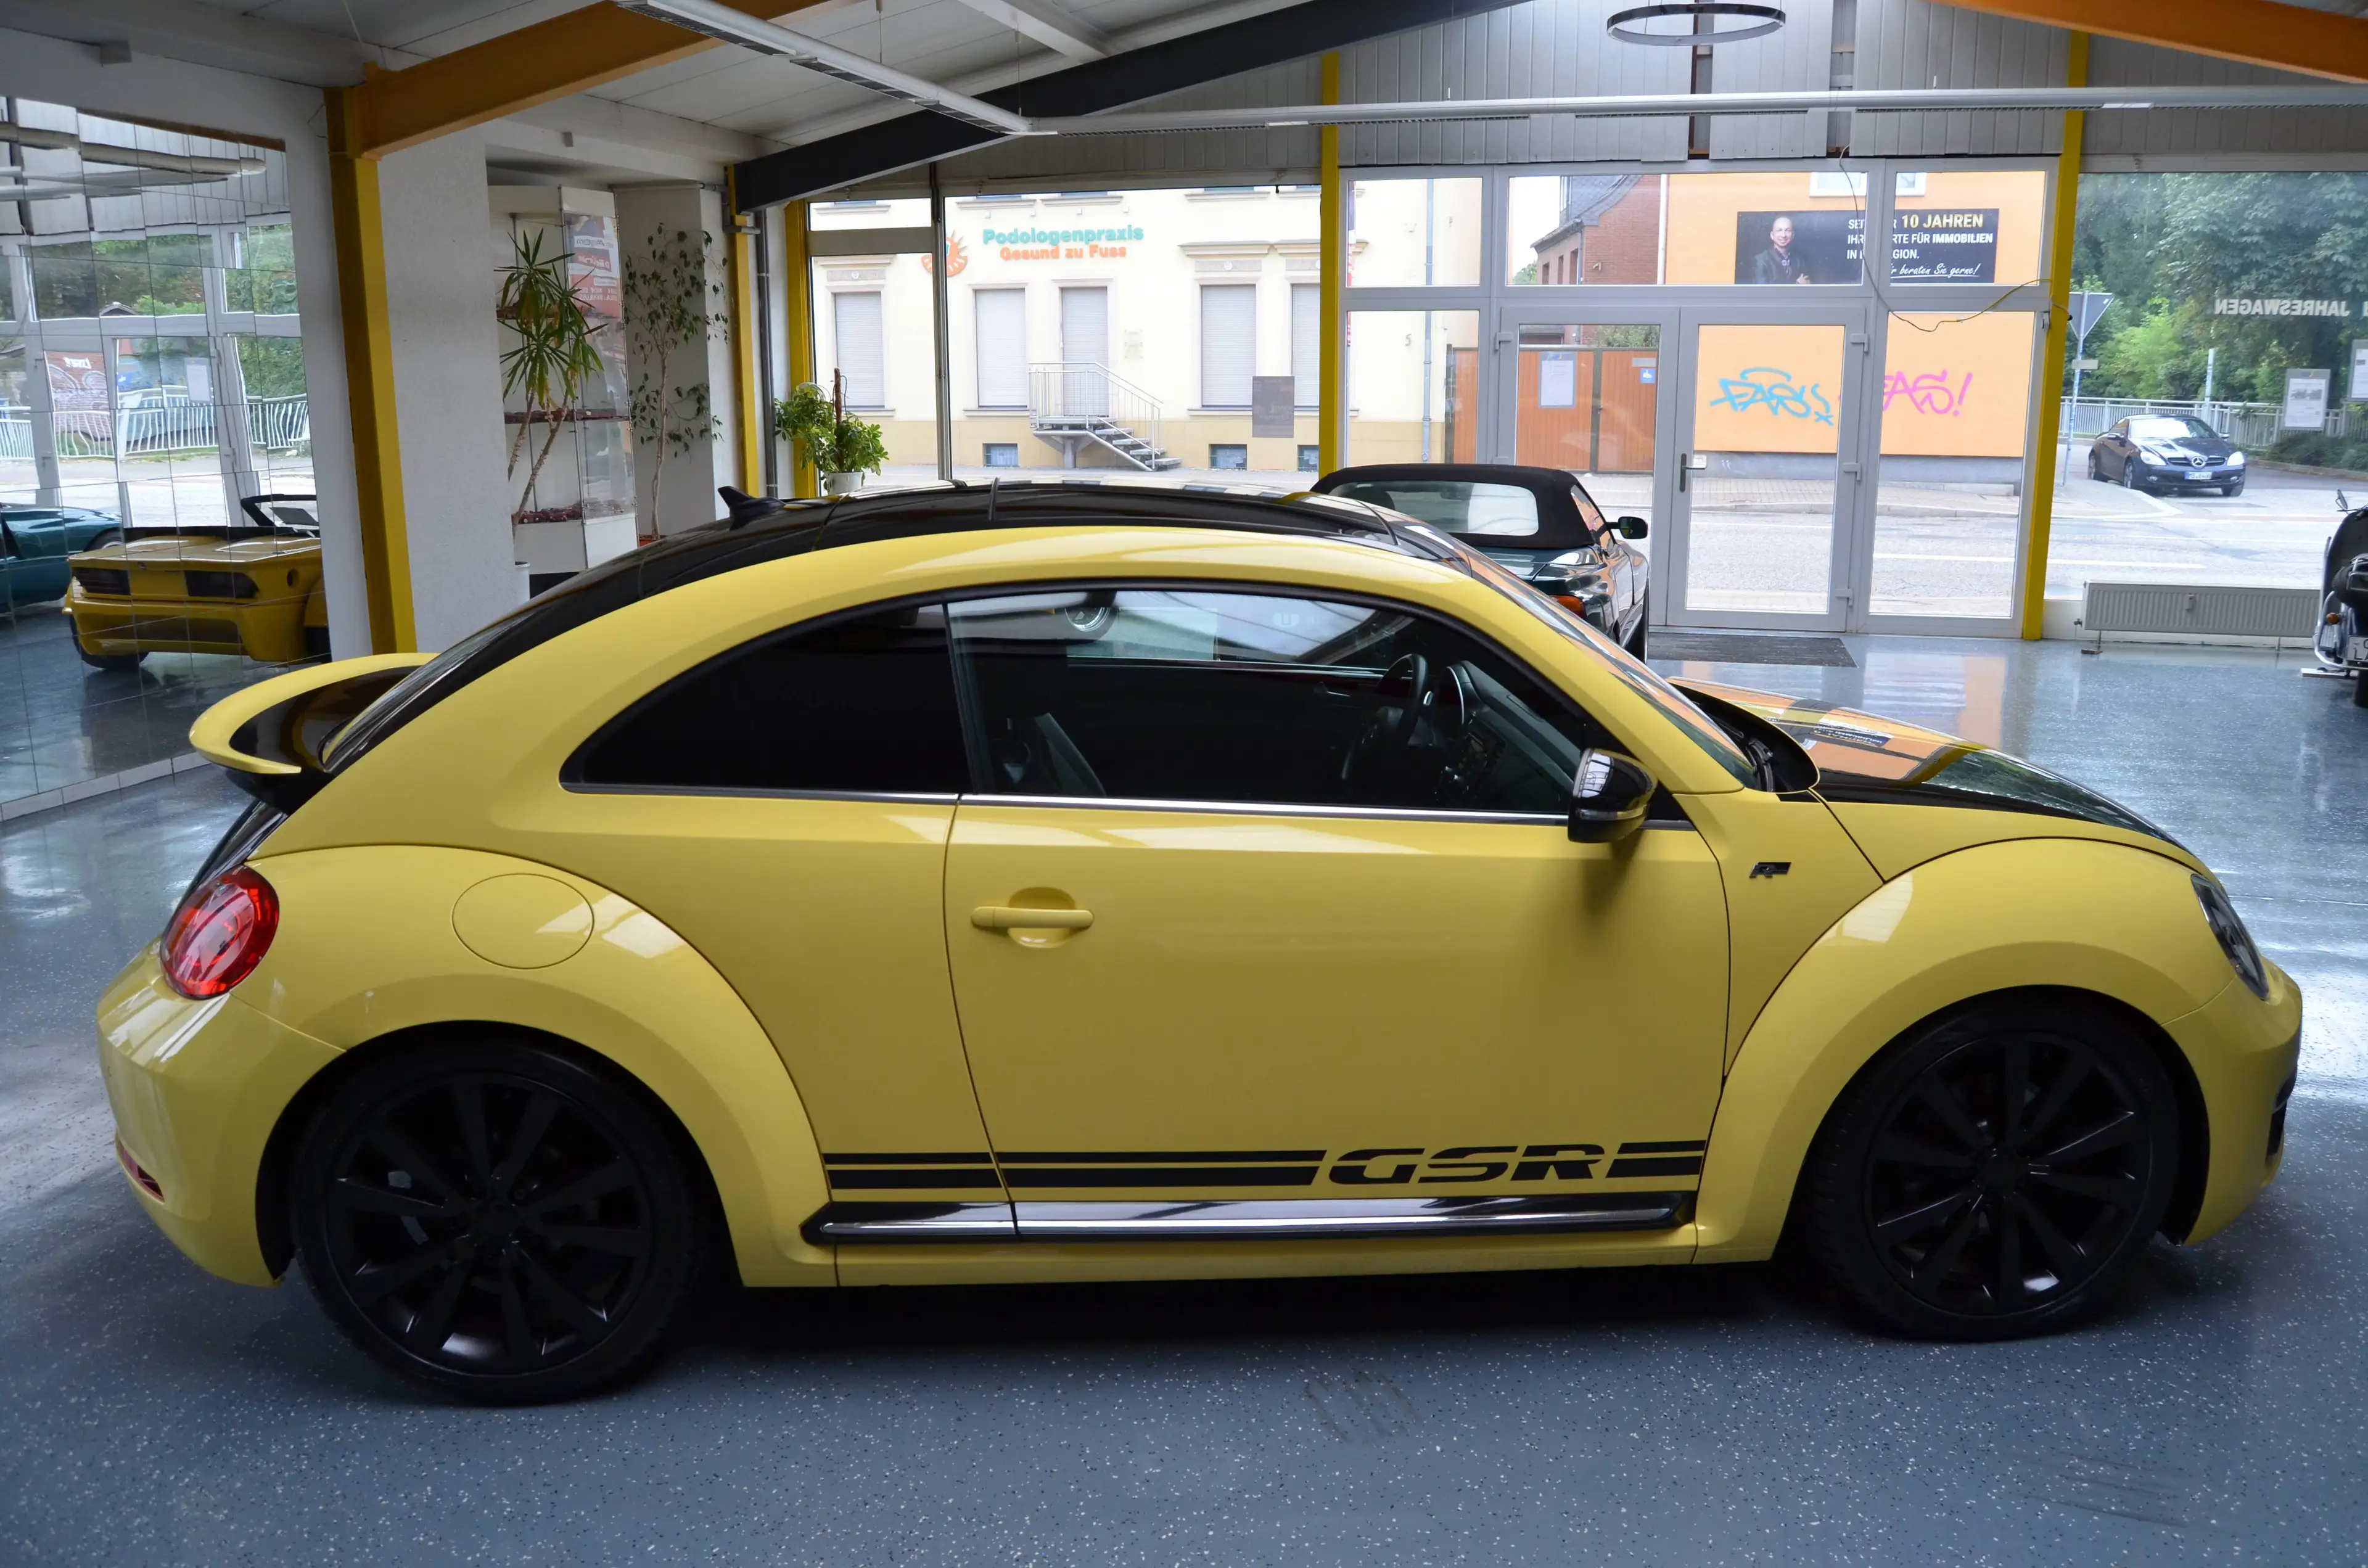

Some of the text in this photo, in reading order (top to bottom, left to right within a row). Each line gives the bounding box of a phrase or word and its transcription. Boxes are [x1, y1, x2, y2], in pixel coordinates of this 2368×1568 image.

[1902, 215, 1919, 228] 10
[1923, 213, 1983, 228] JAHREN
[983, 224, 1144, 245] Podologenpraxis
[1912, 232, 1930, 244] FÜR
[1932, 233, 1993, 244] IMMOBILIEN
[1000, 244, 1127, 261] Gesund zu Fuss
[1847, 249, 1857, 259] IN
[1892, 249, 1920, 259] GION.
[1899, 264, 1931, 275] beraten
[1934, 263, 1947, 275] Sie
[1949, 263, 1981, 278] gerne!
[1405, 334, 1412, 347] 5
[1328, 1144, 1605, 1185] GSR
